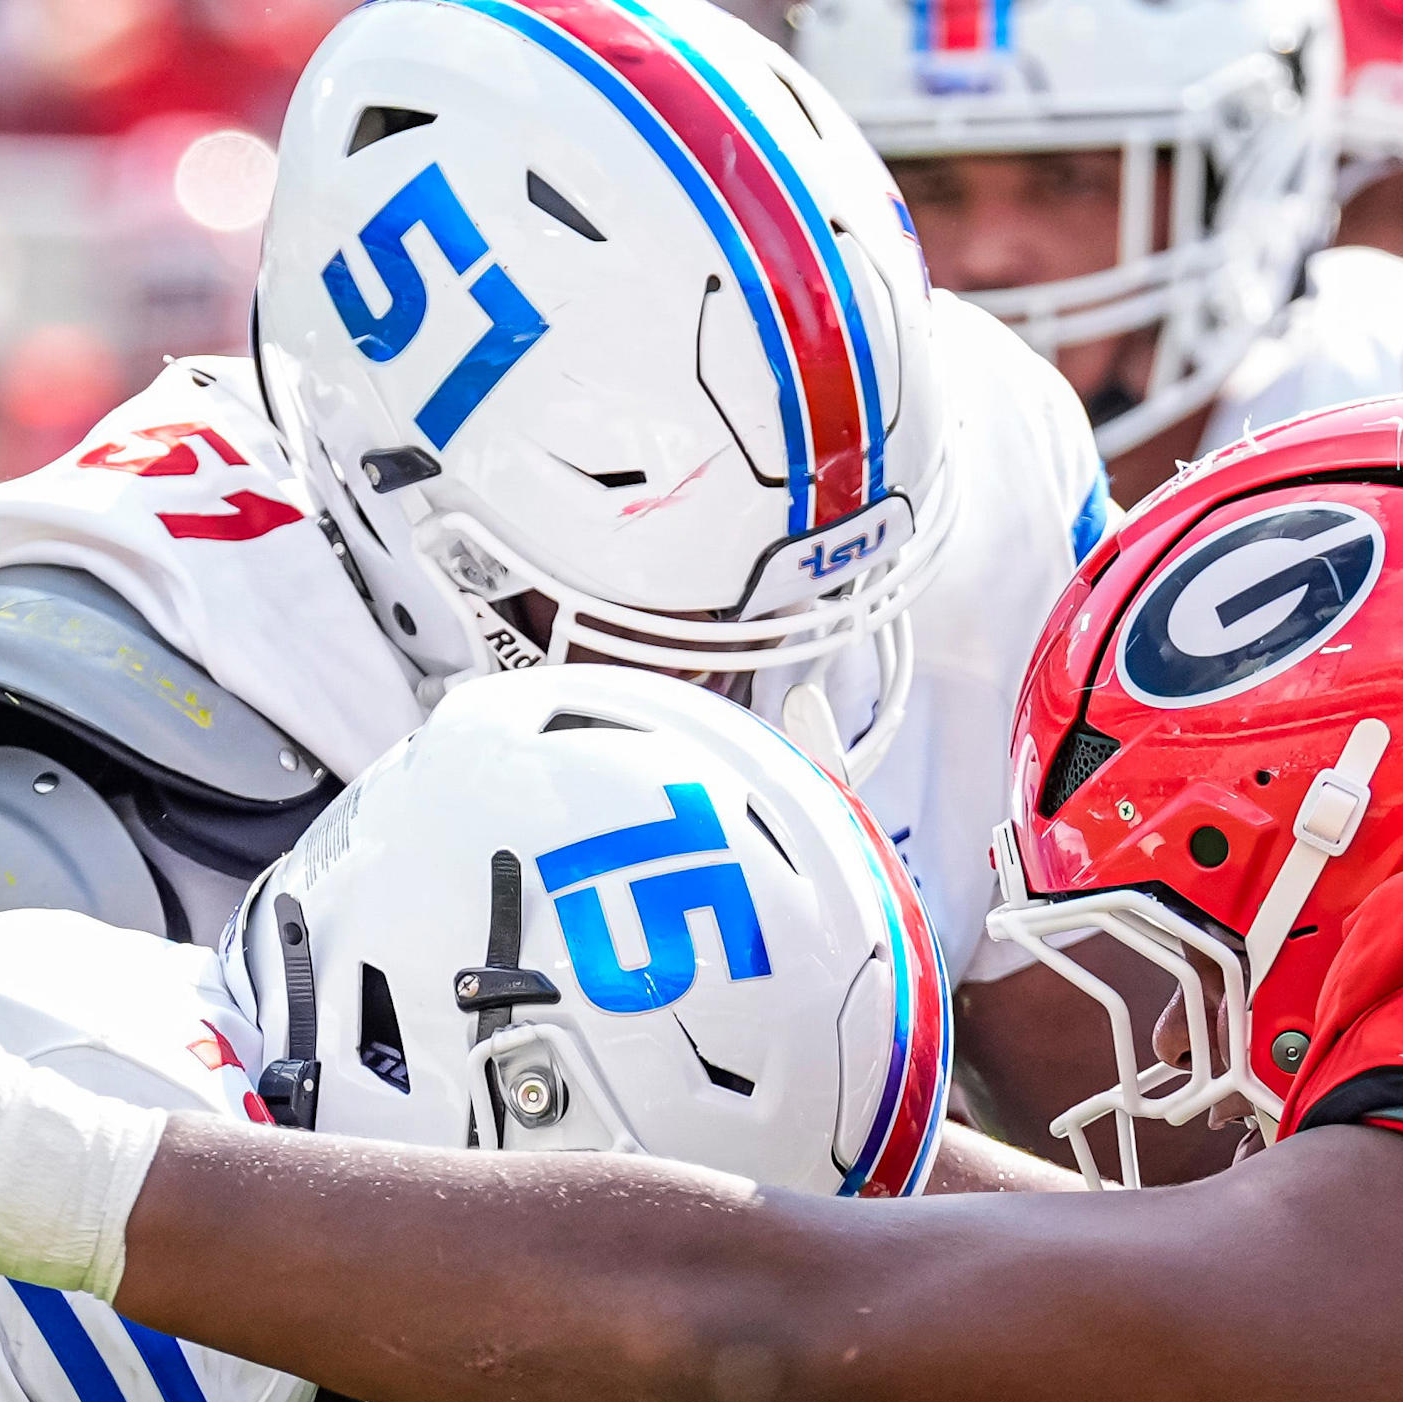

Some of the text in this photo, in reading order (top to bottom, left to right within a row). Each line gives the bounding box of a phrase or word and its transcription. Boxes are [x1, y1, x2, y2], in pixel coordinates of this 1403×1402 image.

[320, 160, 552, 453] 57
[1116, 501, 1384, 707] G
[534, 780, 774, 1018] 15
